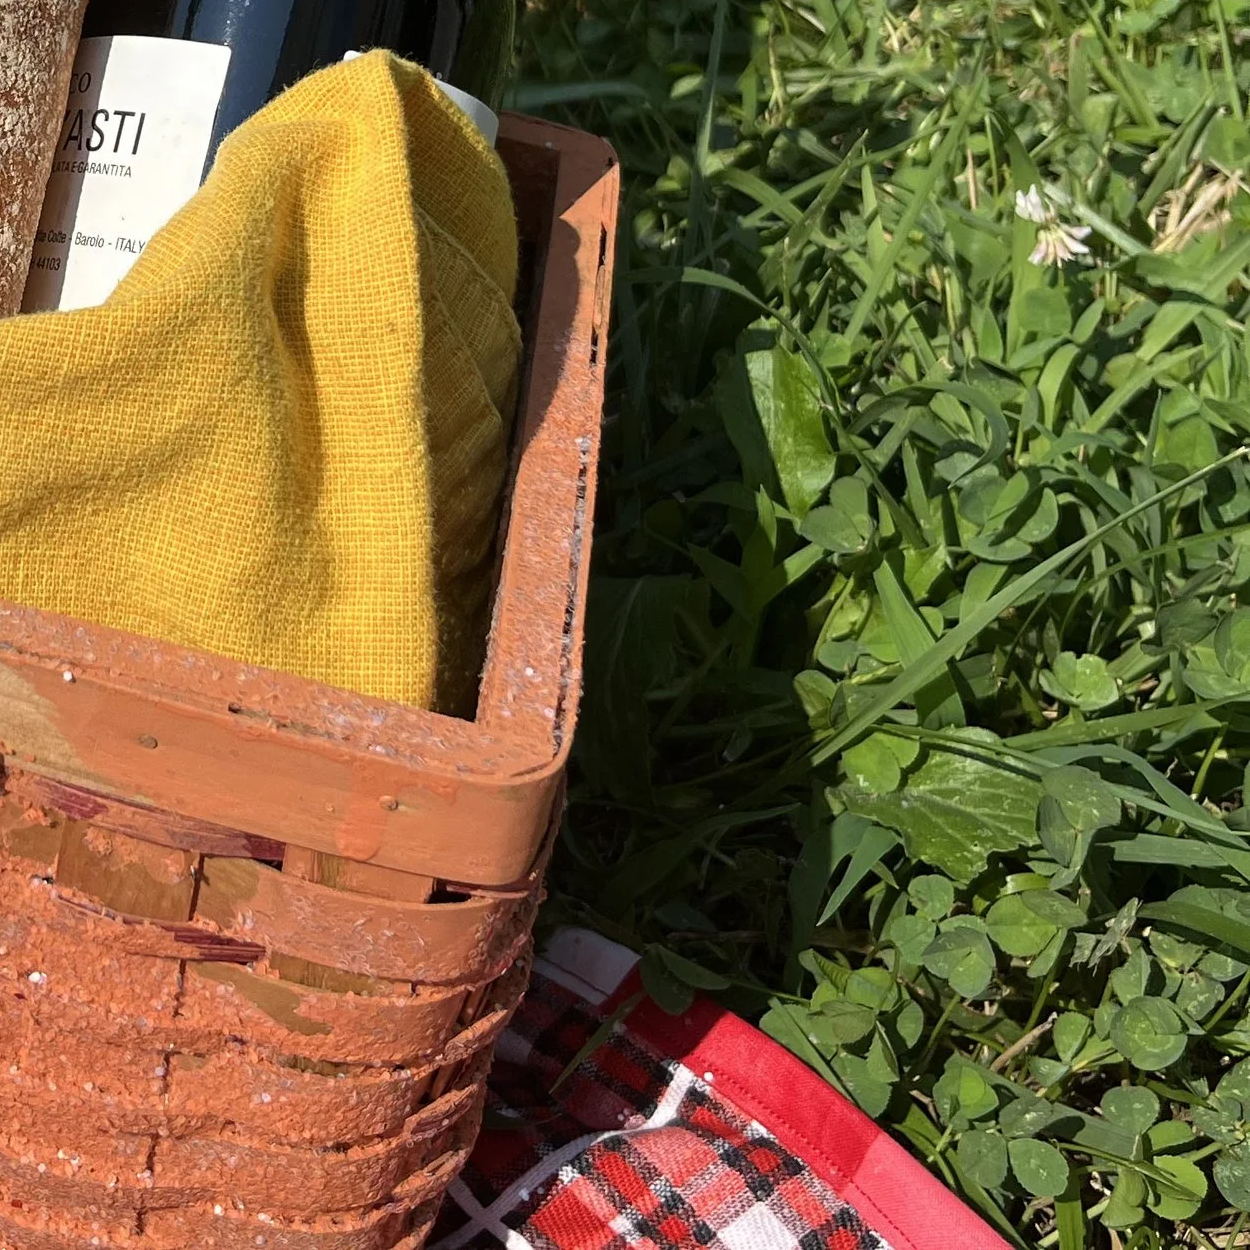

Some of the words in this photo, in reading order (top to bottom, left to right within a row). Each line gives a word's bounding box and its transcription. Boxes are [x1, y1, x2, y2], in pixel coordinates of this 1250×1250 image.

[77, 162, 133, 178] GARANTITA
[74, 231, 105, 249] Barolo
[114, 237, 146, 255] ITALY
